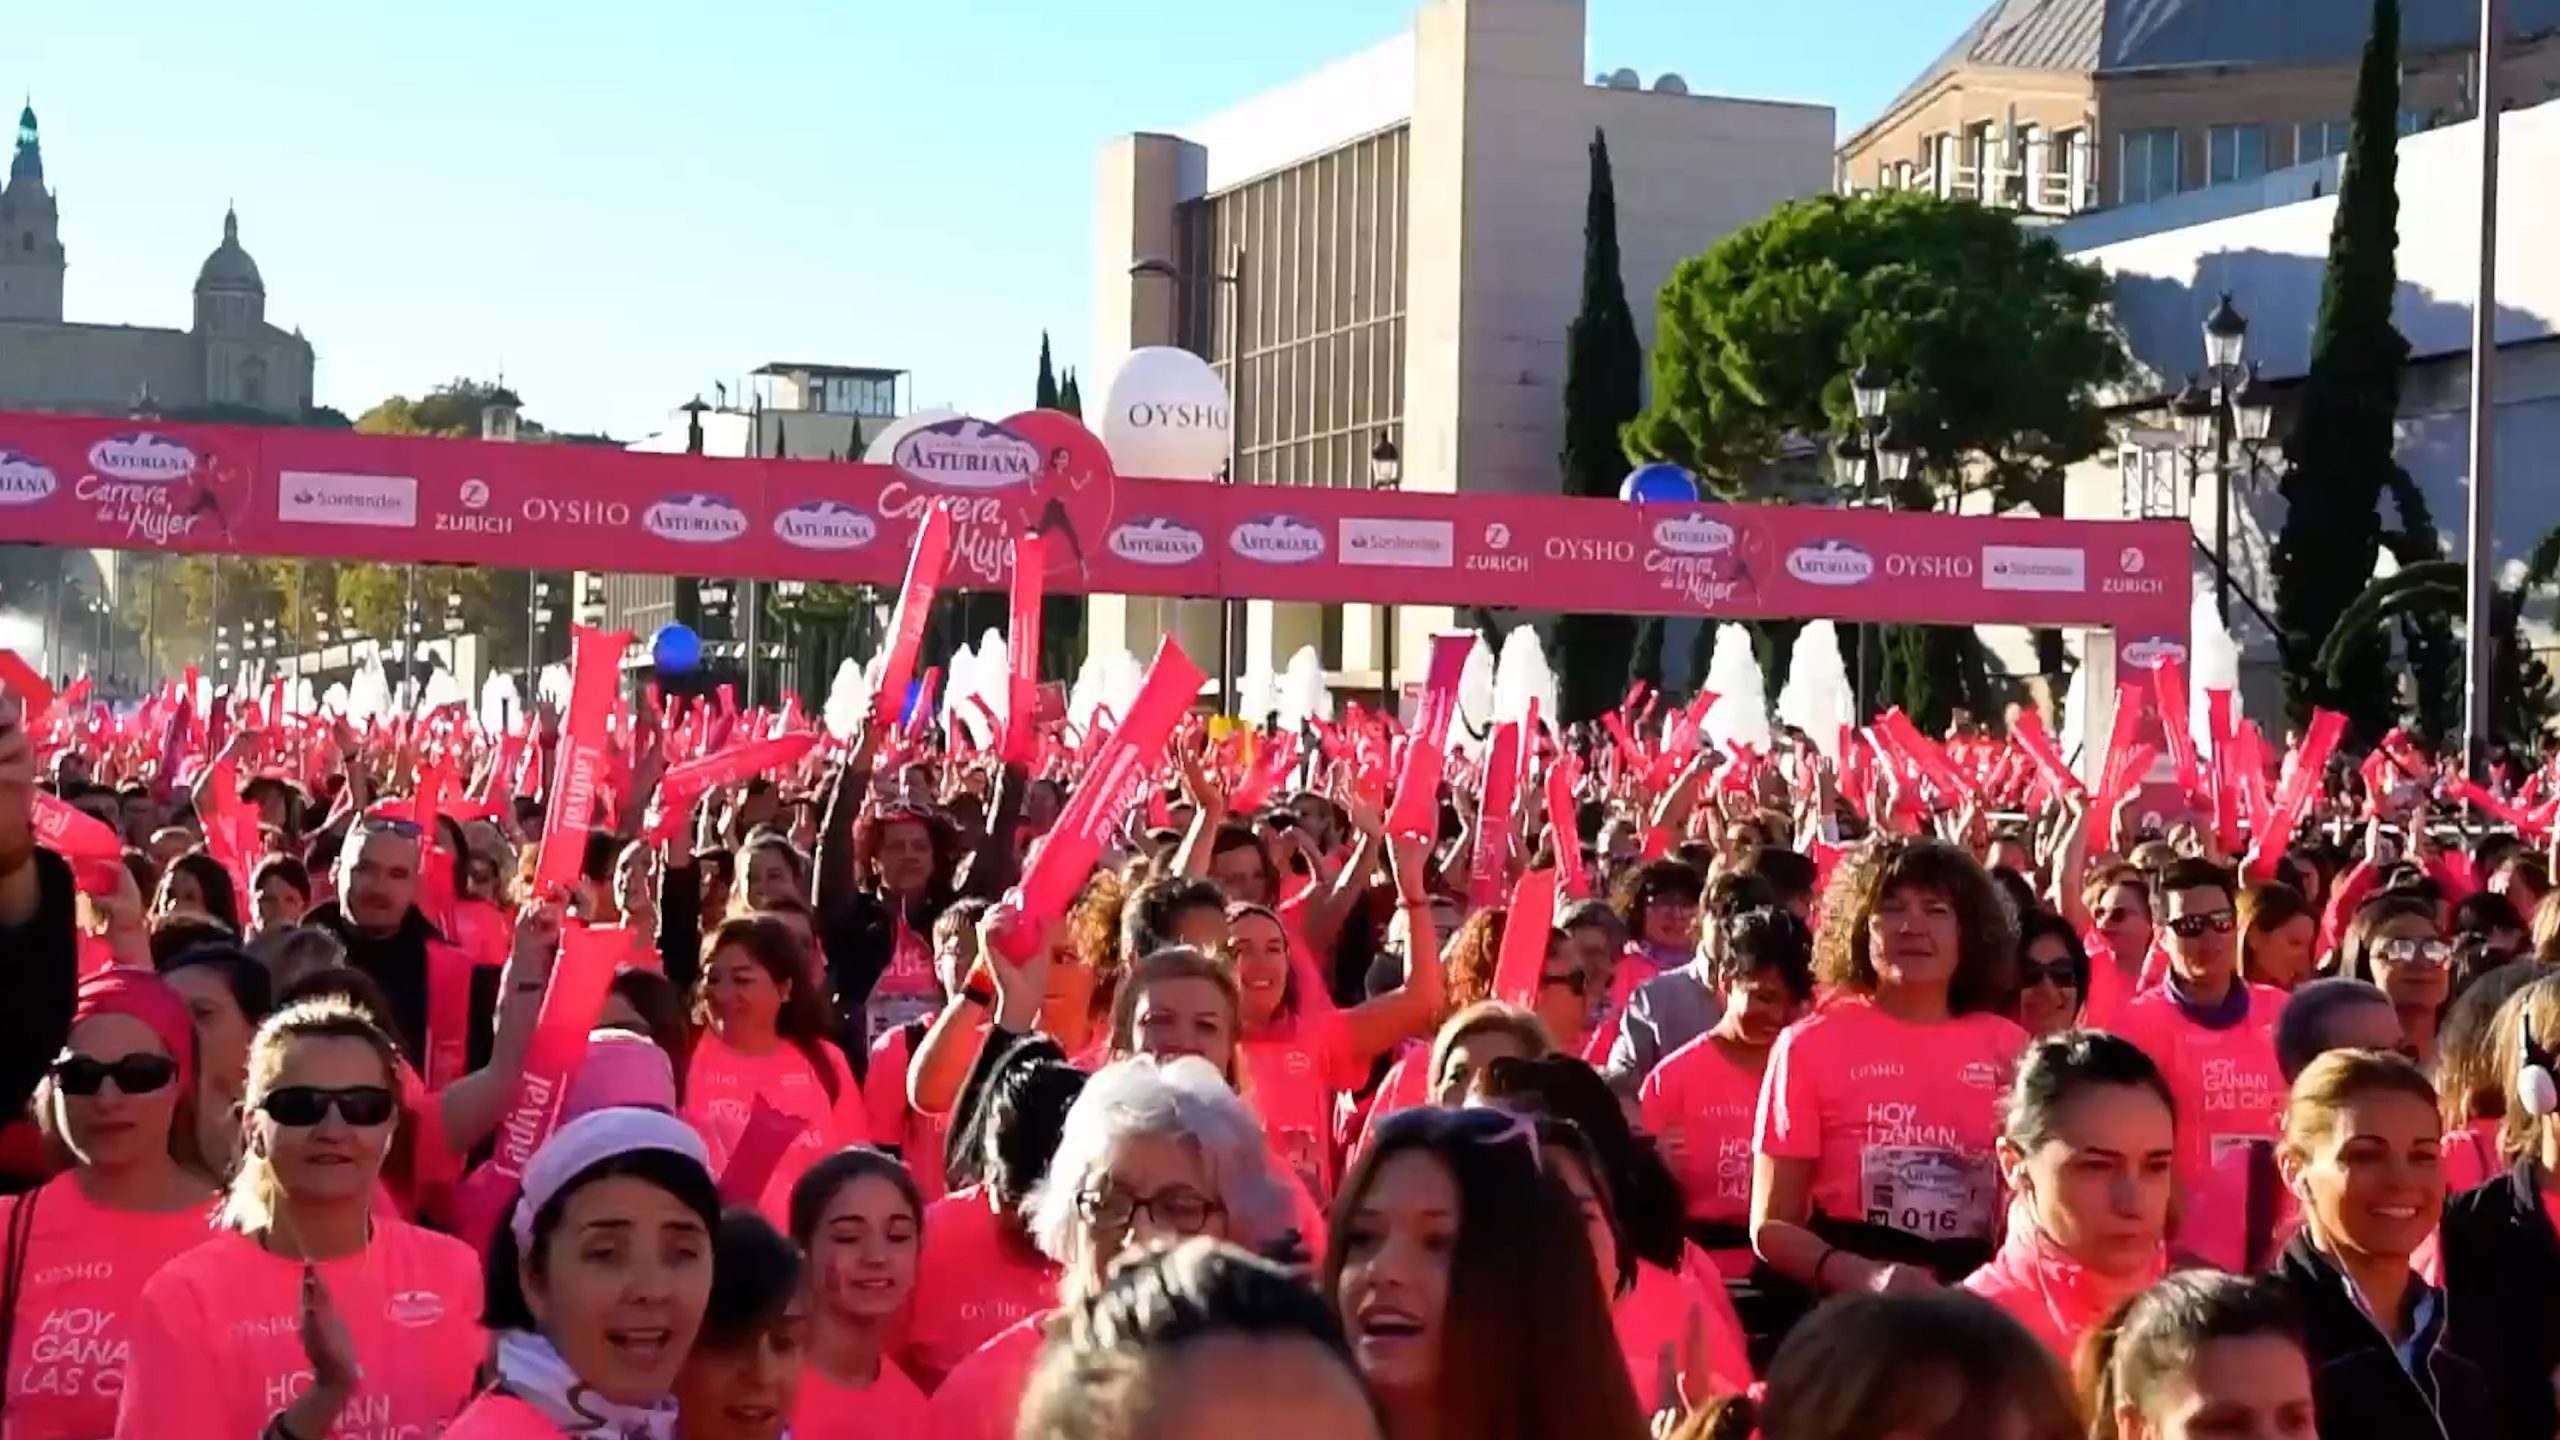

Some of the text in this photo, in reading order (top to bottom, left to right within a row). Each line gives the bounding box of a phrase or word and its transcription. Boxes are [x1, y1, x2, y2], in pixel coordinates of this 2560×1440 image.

[97, 447, 189, 471] ASTURIANA
[906, 440, 1030, 475] ASTURIANA
[75, 475, 167, 507] Carrera
[126, 501, 199, 546] Mujer
[435, 512, 513, 535] ZURICH
[522, 498, 631, 526] OYSHO
[650, 510, 740, 533] ASTURIANA
[781, 516, 869, 538] ASTURIANA
[1116, 533, 1198, 554] ASTURIANA
[1240, 530, 1319, 553] ASTURIANA
[1545, 536, 1634, 562] OYSHO
[1465, 554, 1529, 573] ZURICH
[1644, 548, 1714, 576] Carrera
[1885, 553, 1973, 578] OYSHO
[1684, 572, 1738, 609] Mujer
[2101, 577, 2163, 593] ZURICH
[1867, 1102, 1917, 1125] HOY
[1901, 1207, 1958, 1232] 016
[40, 1308, 116, 1336] HOY
[31, 1333, 130, 1365] GANA
[21, 1365, 84, 1397] LAS
